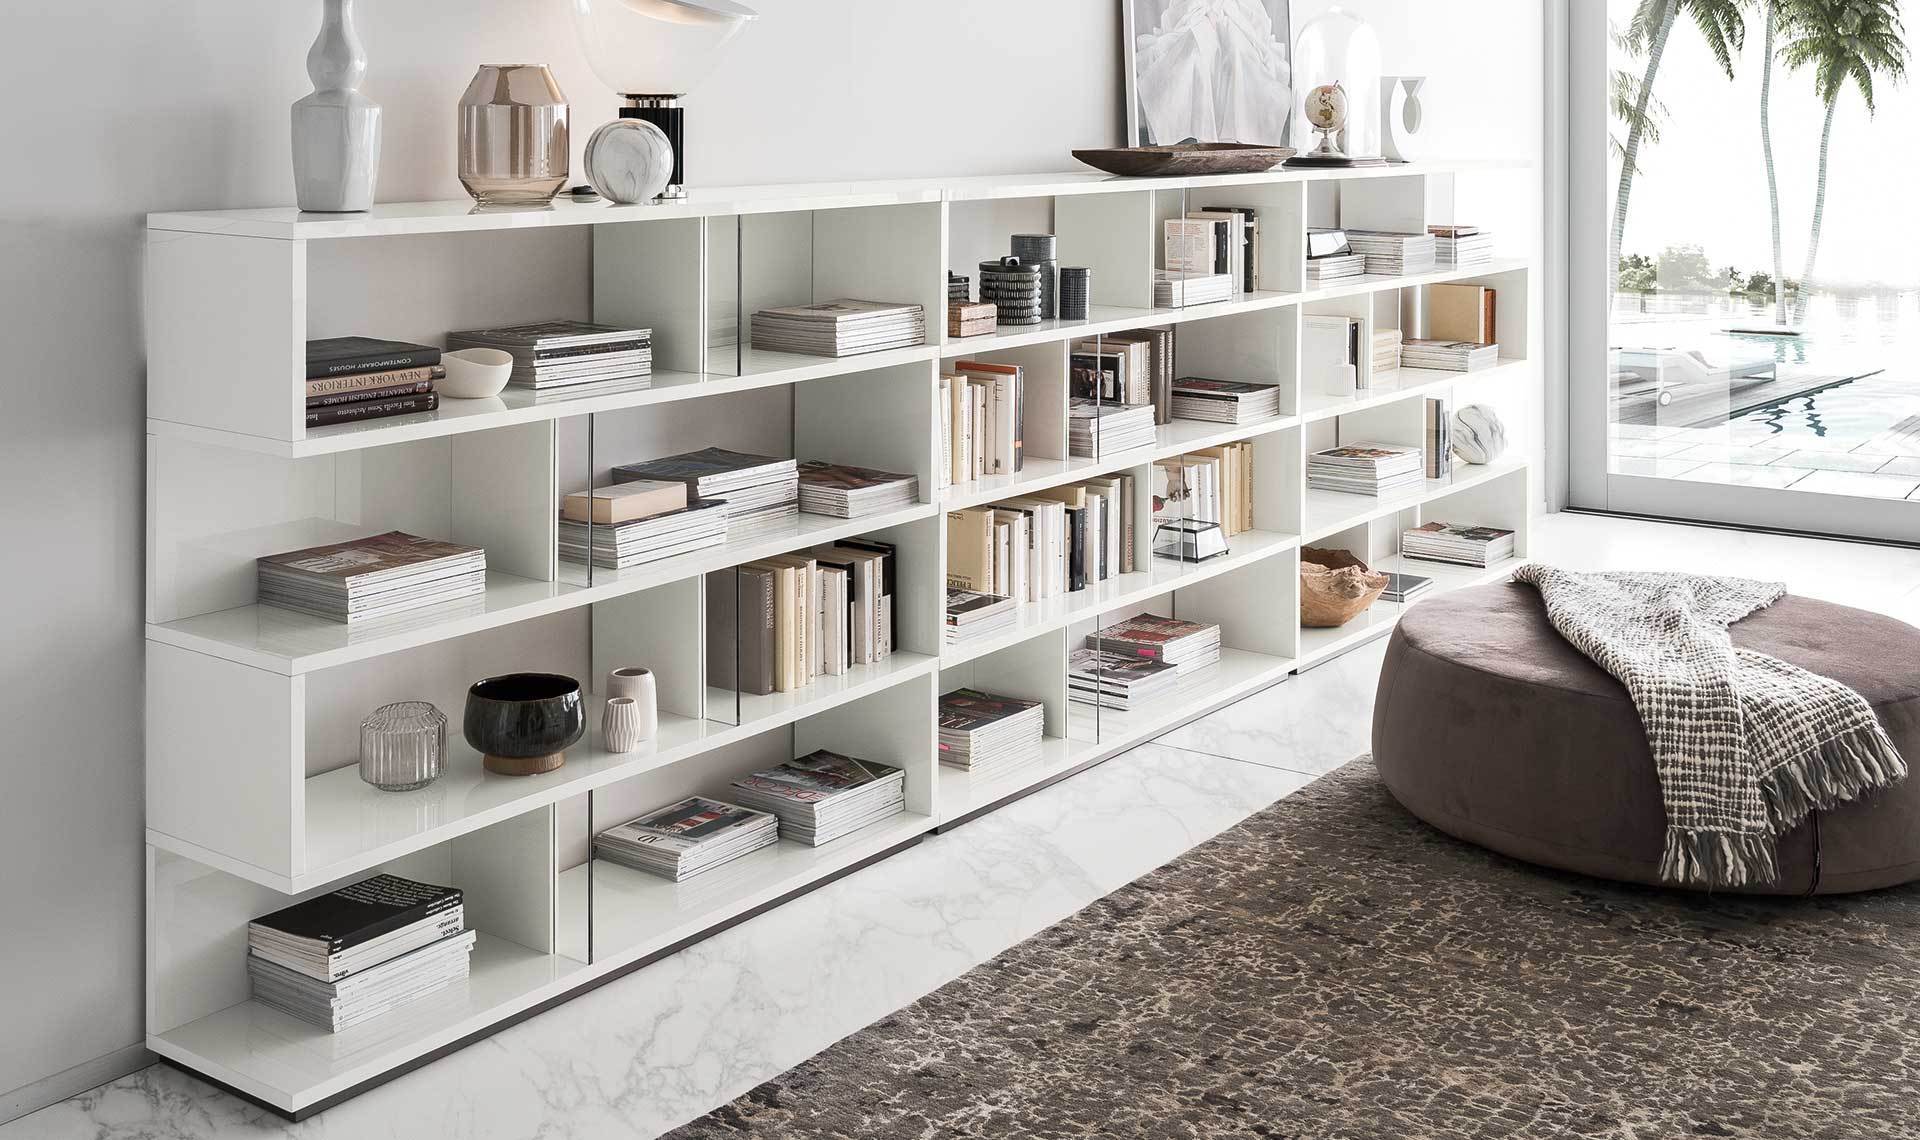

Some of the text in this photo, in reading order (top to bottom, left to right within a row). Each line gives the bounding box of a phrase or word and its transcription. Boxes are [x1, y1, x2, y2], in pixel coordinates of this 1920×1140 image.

[329, 357, 412, 372] CONTEMPORARY HOUSES
[311, 370, 421, 393] NEW YORK INTERIORS
[347, 392, 377, 403] ENGLISH
[378, 387, 413, 398] ROMANTIC
[322, 396, 347, 406] HOMES
[336, 406, 367, 416] Architetto
[637, 834, 665, 844] AD
